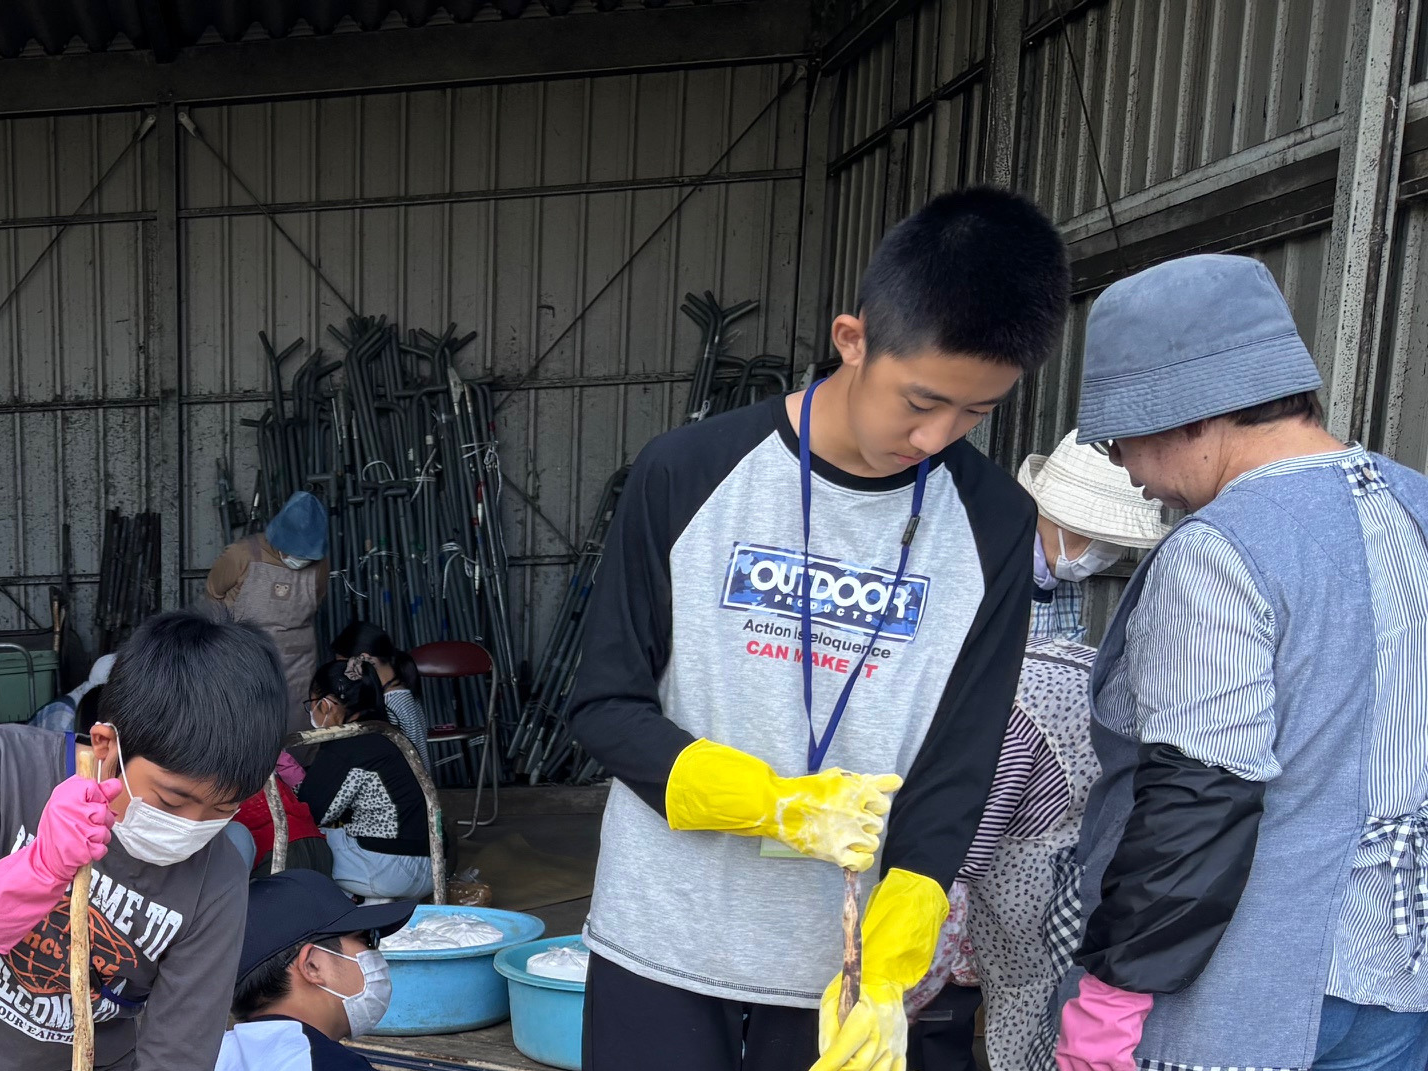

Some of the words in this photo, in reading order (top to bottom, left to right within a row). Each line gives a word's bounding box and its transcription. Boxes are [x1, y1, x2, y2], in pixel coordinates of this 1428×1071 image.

[750, 560, 907, 618] OUTDOOR
[743, 619, 791, 641] Action
[810, 632, 891, 659] eloquence
[746, 640, 789, 662] CAN
